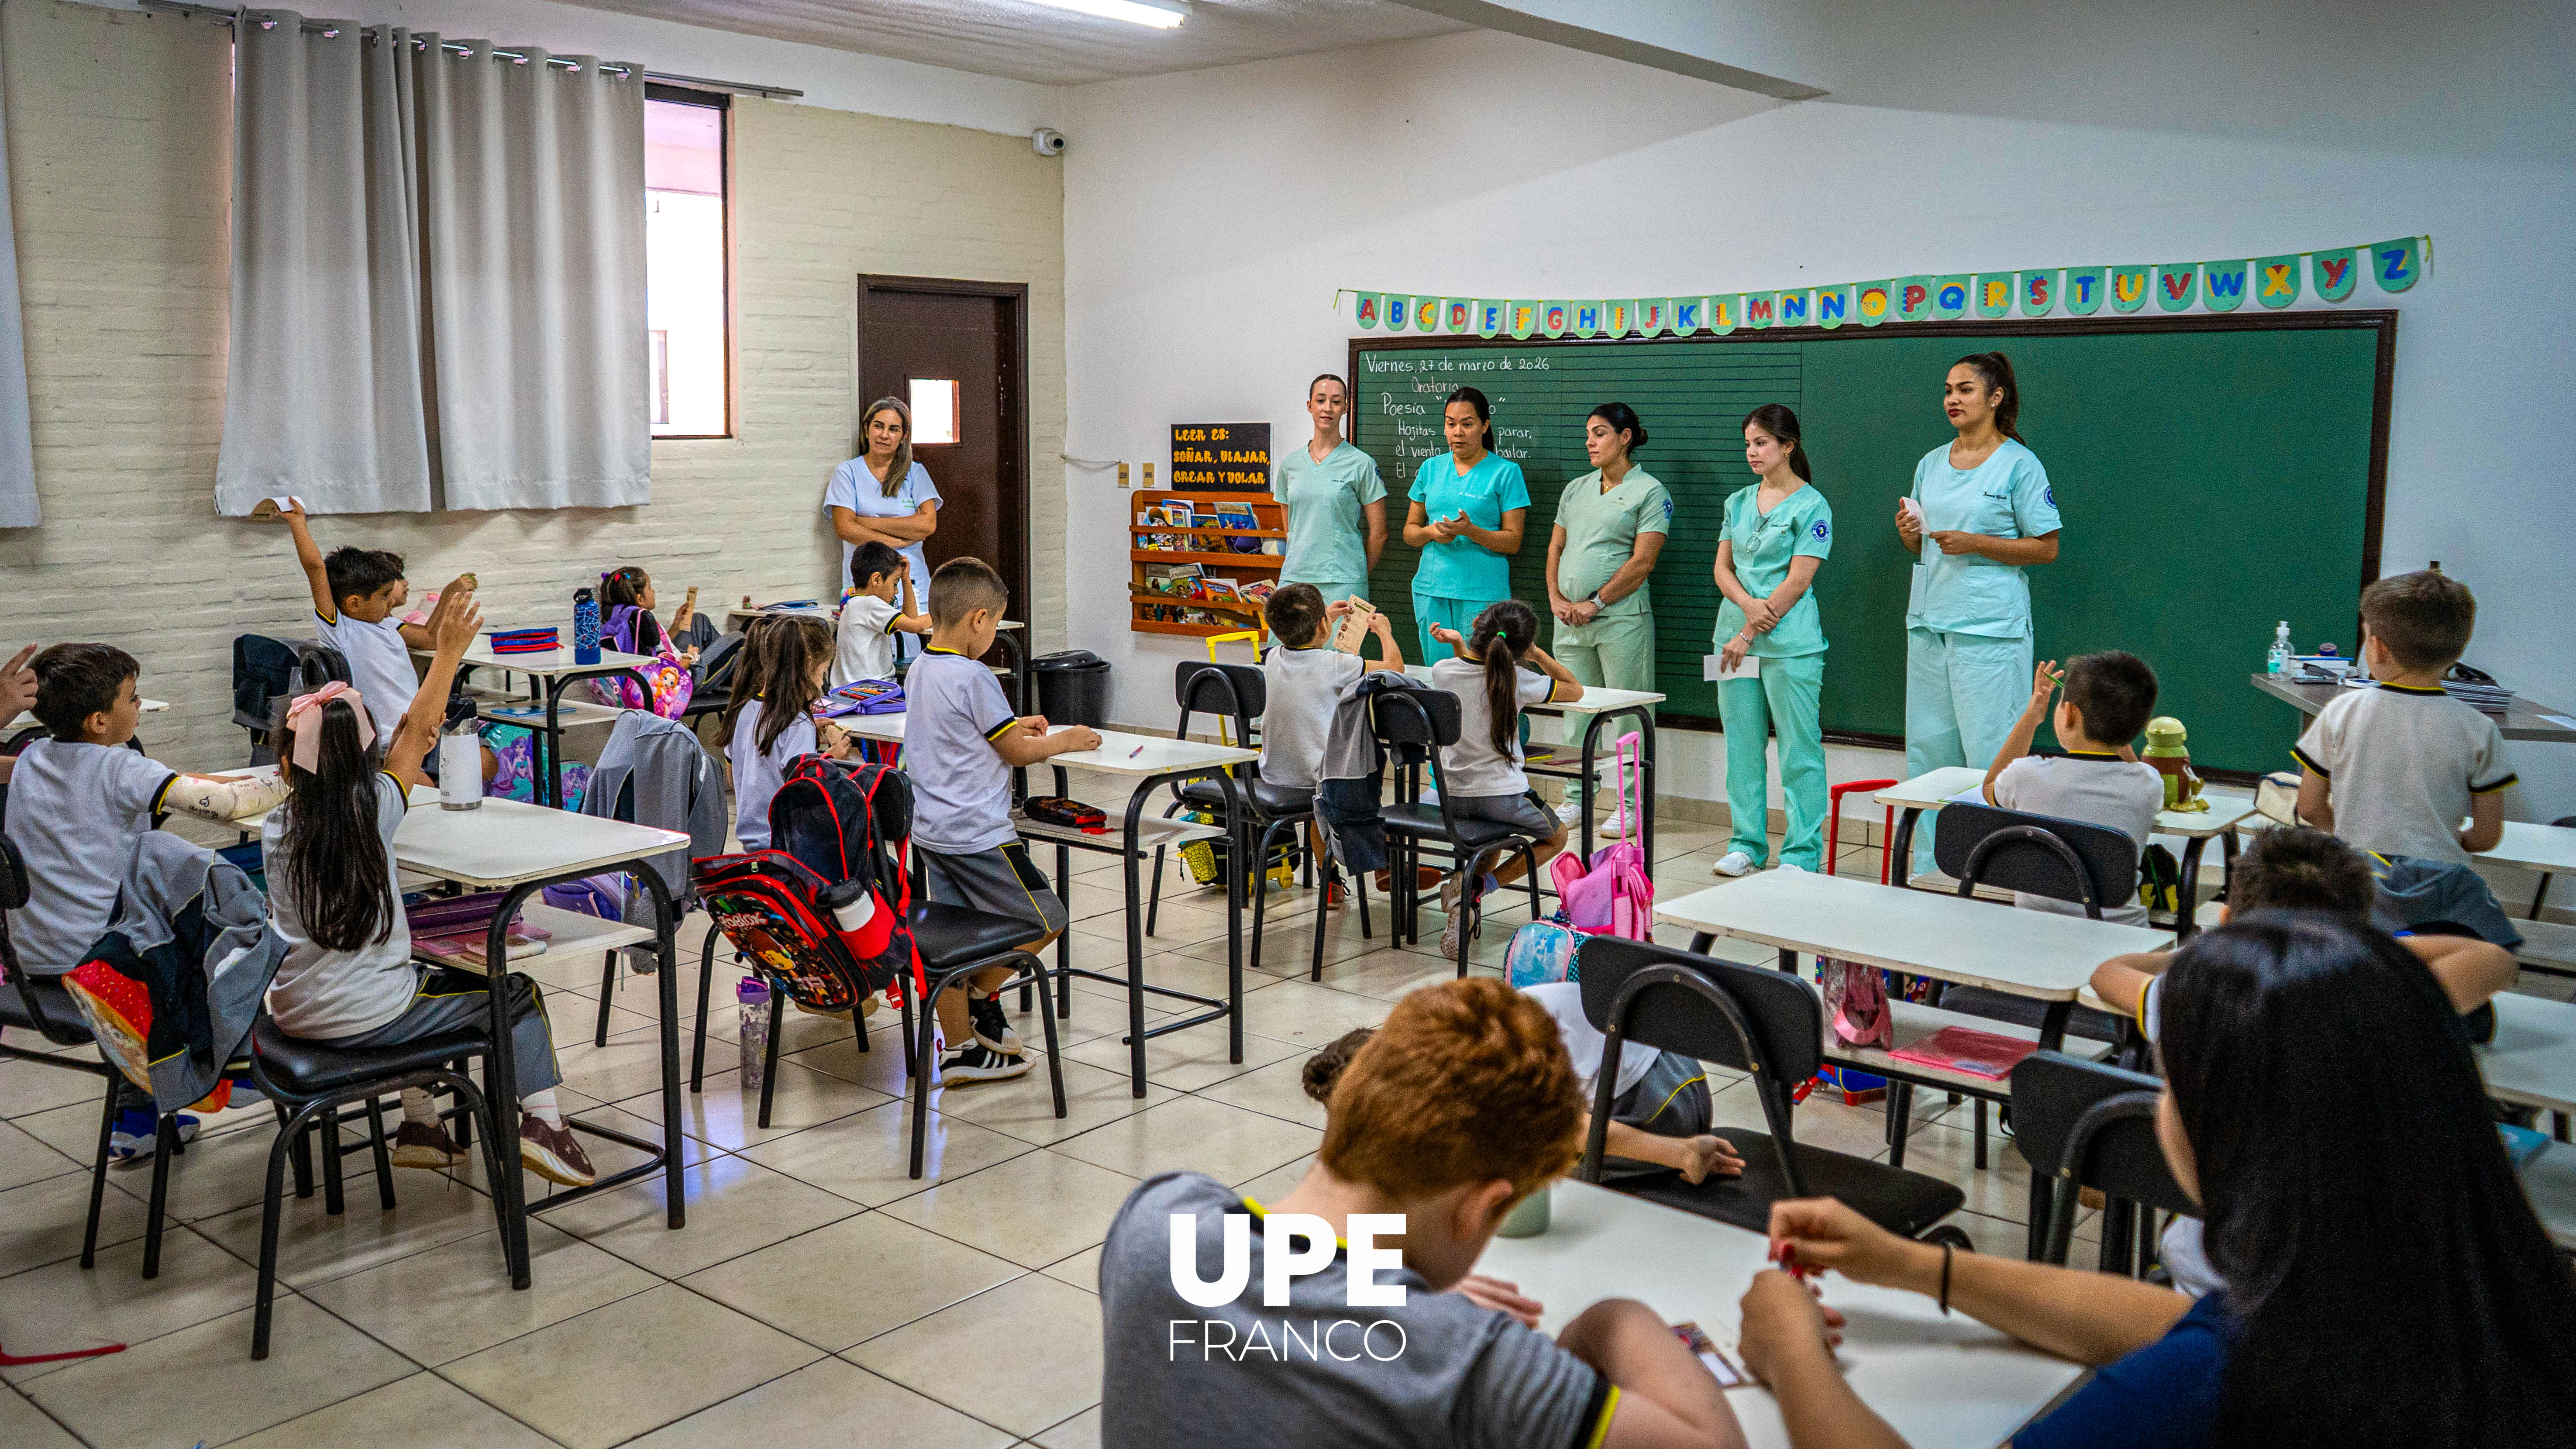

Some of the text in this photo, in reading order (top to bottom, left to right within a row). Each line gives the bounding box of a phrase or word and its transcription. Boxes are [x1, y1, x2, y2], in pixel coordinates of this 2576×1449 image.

[1359, 299, 1376, 320] A
[1390, 301, 1403, 323] B
[1420, 302, 1434, 324] C
[1452, 304, 1466, 325] D
[1484, 307, 1497, 330] E
[1516, 308, 1531, 330] F
[1548, 307, 1563, 330] G
[1578, 306, 1595, 330] H
[1615, 307, 1623, 330] I
[1645, 306, 1658, 329] J
[1677, 305, 1696, 327] K
[1717, 303, 1732, 326] L
[1750, 299, 1772, 322] M
[1783, 295, 1806, 318] N
[1861, 288, 1887, 317] O
[1903, 285, 1926, 313] P
[1939, 283, 1964, 310] Q
[1984, 281, 2008, 307] R
[2030, 277, 2048, 305] S
[2076, 276, 2096, 303] T
[2116, 274, 2144, 302] U
[2163, 272, 2192, 300] V
[2206, 272, 2244, 297] W
[2264, 264, 2293, 297] X
[2321, 258, 2349, 289] Y
[2382, 249, 2410, 280] Z
[1419, 360, 1434, 371] 27
[1439, 356, 1453, 371] de
[1459, 361, 1495, 371] marzo
[1500, 356, 1512, 370] de
[1519, 356, 1549, 370] 2026
[1412, 376, 1459, 392] Oratoria
[1175, 428, 1229, 441] LEER ES:
[1398, 419, 1531, 445] Hojitas parar,
[1174, 447, 1217, 464] SOÑAR,
[1396, 440, 1405, 456] el
[1411, 441, 1440, 458] viento
[1174, 471, 1265, 484] CREAR Y VOLAR
[1396, 462, 1405, 478] El
